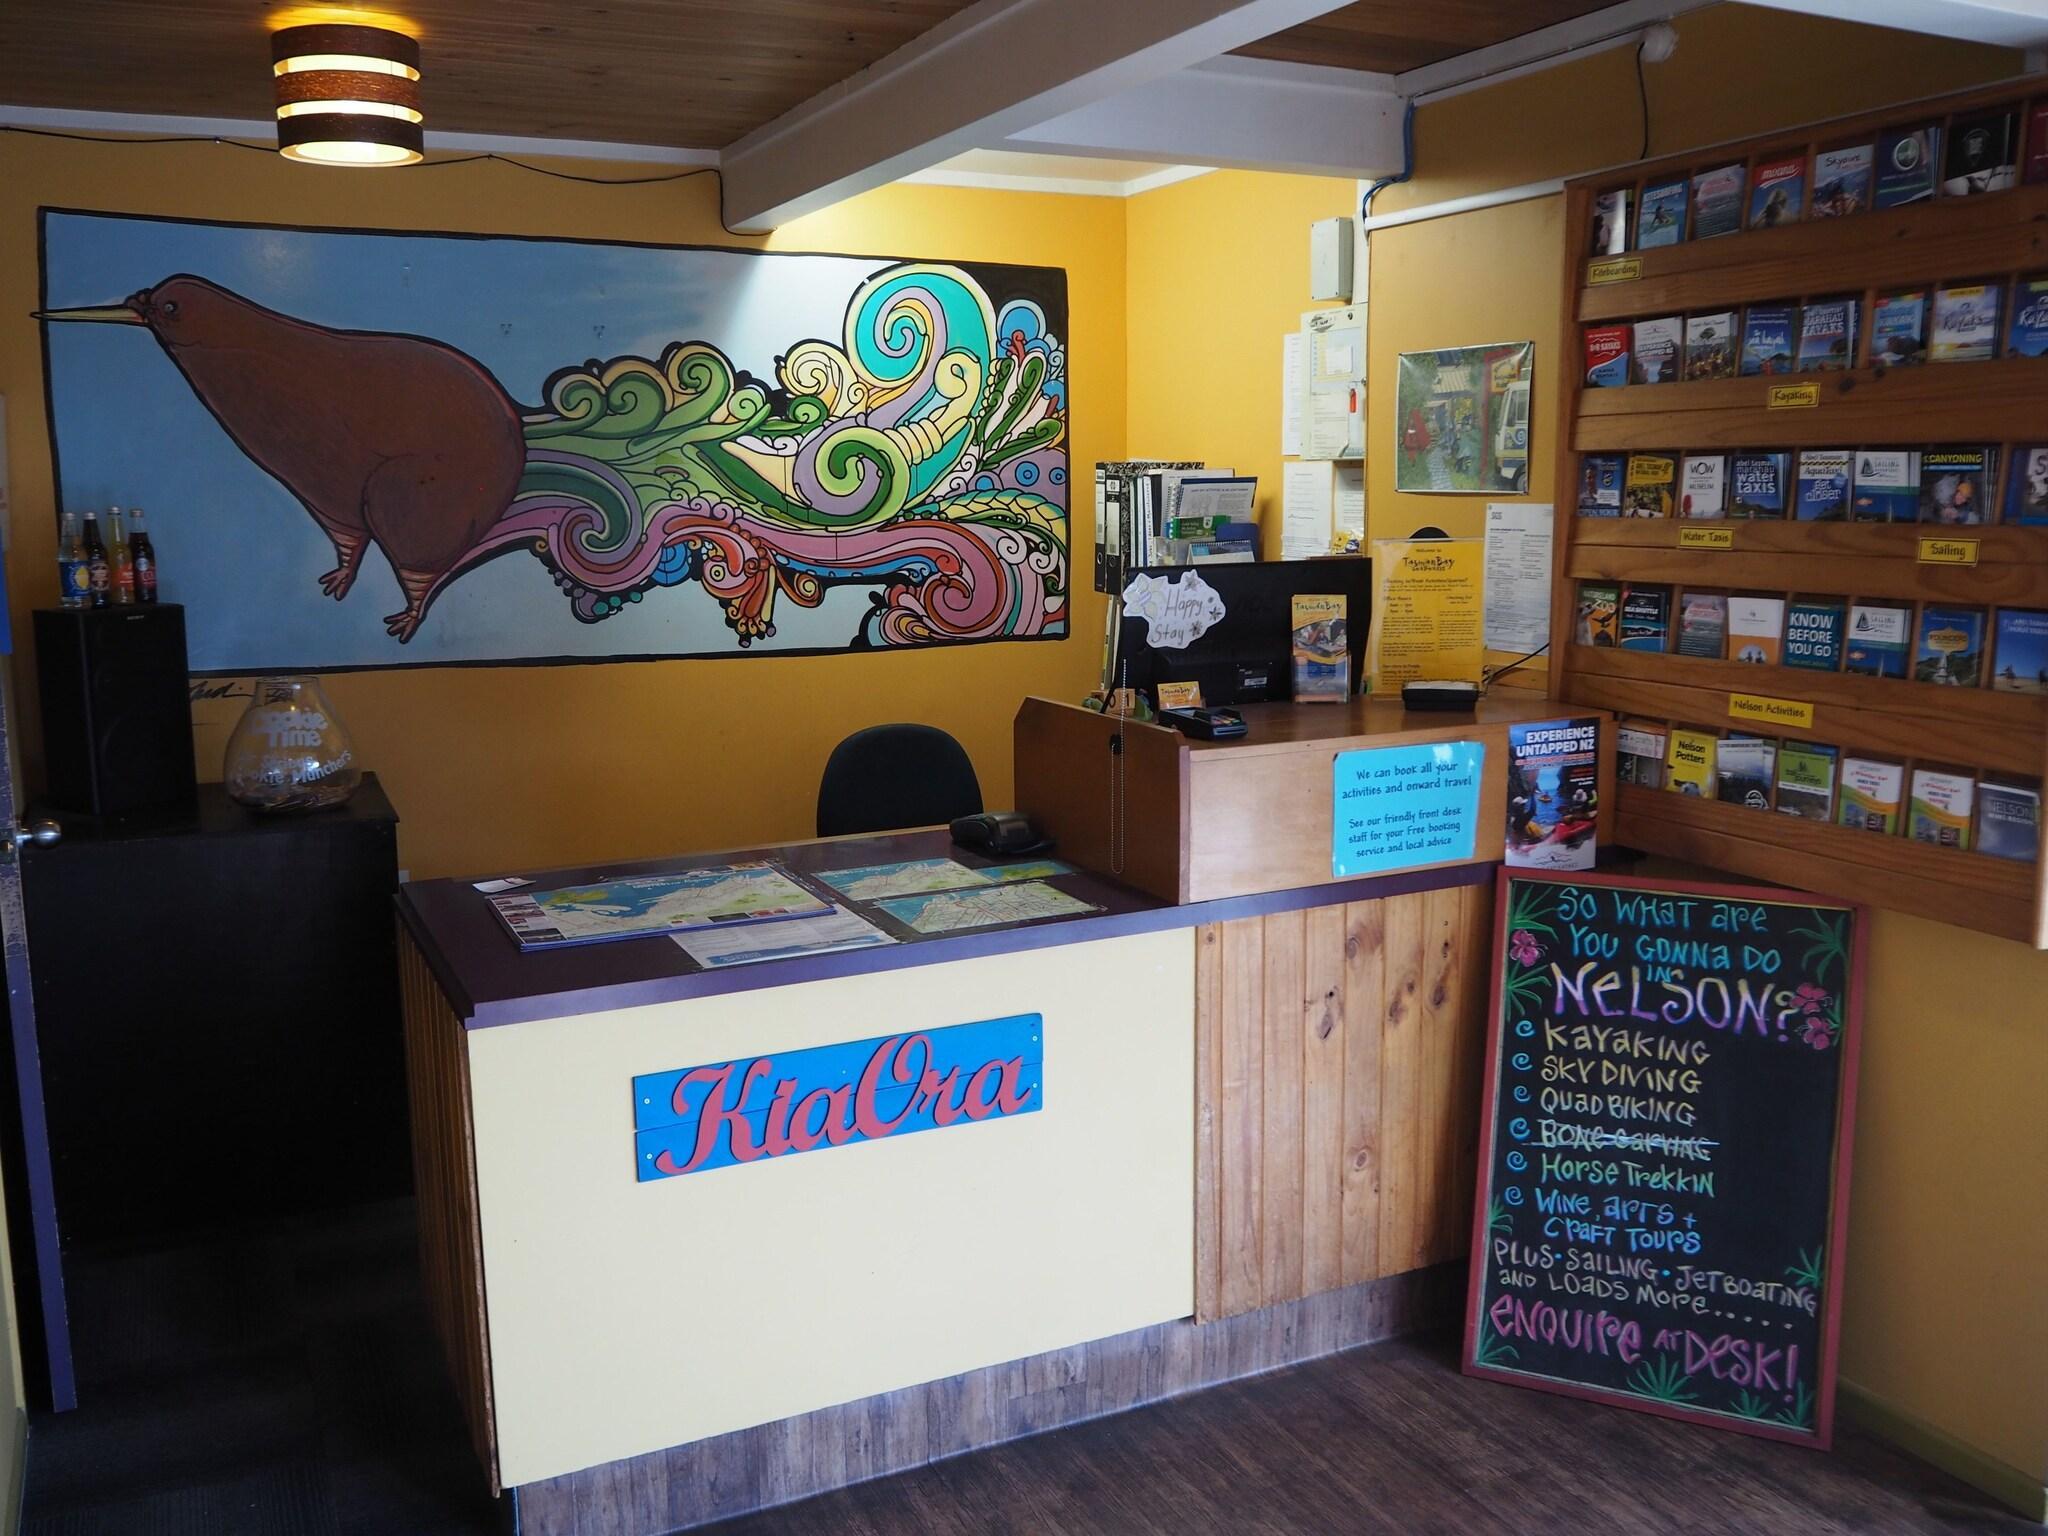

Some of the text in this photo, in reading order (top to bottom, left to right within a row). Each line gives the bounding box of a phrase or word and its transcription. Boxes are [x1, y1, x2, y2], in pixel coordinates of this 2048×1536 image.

[1774, 387, 1814, 405] Kayaking
[1690, 461, 1716, 475] WOW
[1736, 473, 1775, 484] water
[1736, 482, 1776, 494] taxis
[1683, 531, 1729, 542] Water Taxis
[1930, 543, 1966, 561] Sailing
[1164, 588, 1203, 620] Happy
[1594, 599, 1616, 614] ZOO
[1790, 612, 1834, 630] KNOW
[1150, 623, 1184, 646] Stay
[1788, 628, 1833, 644] BEFORE
[1788, 642, 1832, 657] YOU GO
[1735, 700, 1805, 718] Nelson Activities
[267, 729, 323, 748] Time
[1526, 726, 1595, 744] EXPERIENCE
[1516, 738, 1595, 758] UNTAPPED NZ
[1678, 740, 1706, 754] Nelson
[1676, 751, 1706, 765] Potters
[1357, 762, 1458, 781] We can book all your
[1342, 776, 1472, 800] activities and onward travel
[1349, 806, 1462, 829] See our friendly front desk
[1348, 831, 1367, 843] staff
[1370, 828, 1382, 840] for
[1386, 828, 1404, 841] your
[1428, 820, 1460, 834] booking
[1356, 836, 1452, 858] service and local advice
[1569, 922, 1620, 959] YOU
[1744, 946, 1782, 975] DO
[1646, 965, 1674, 983] IN
